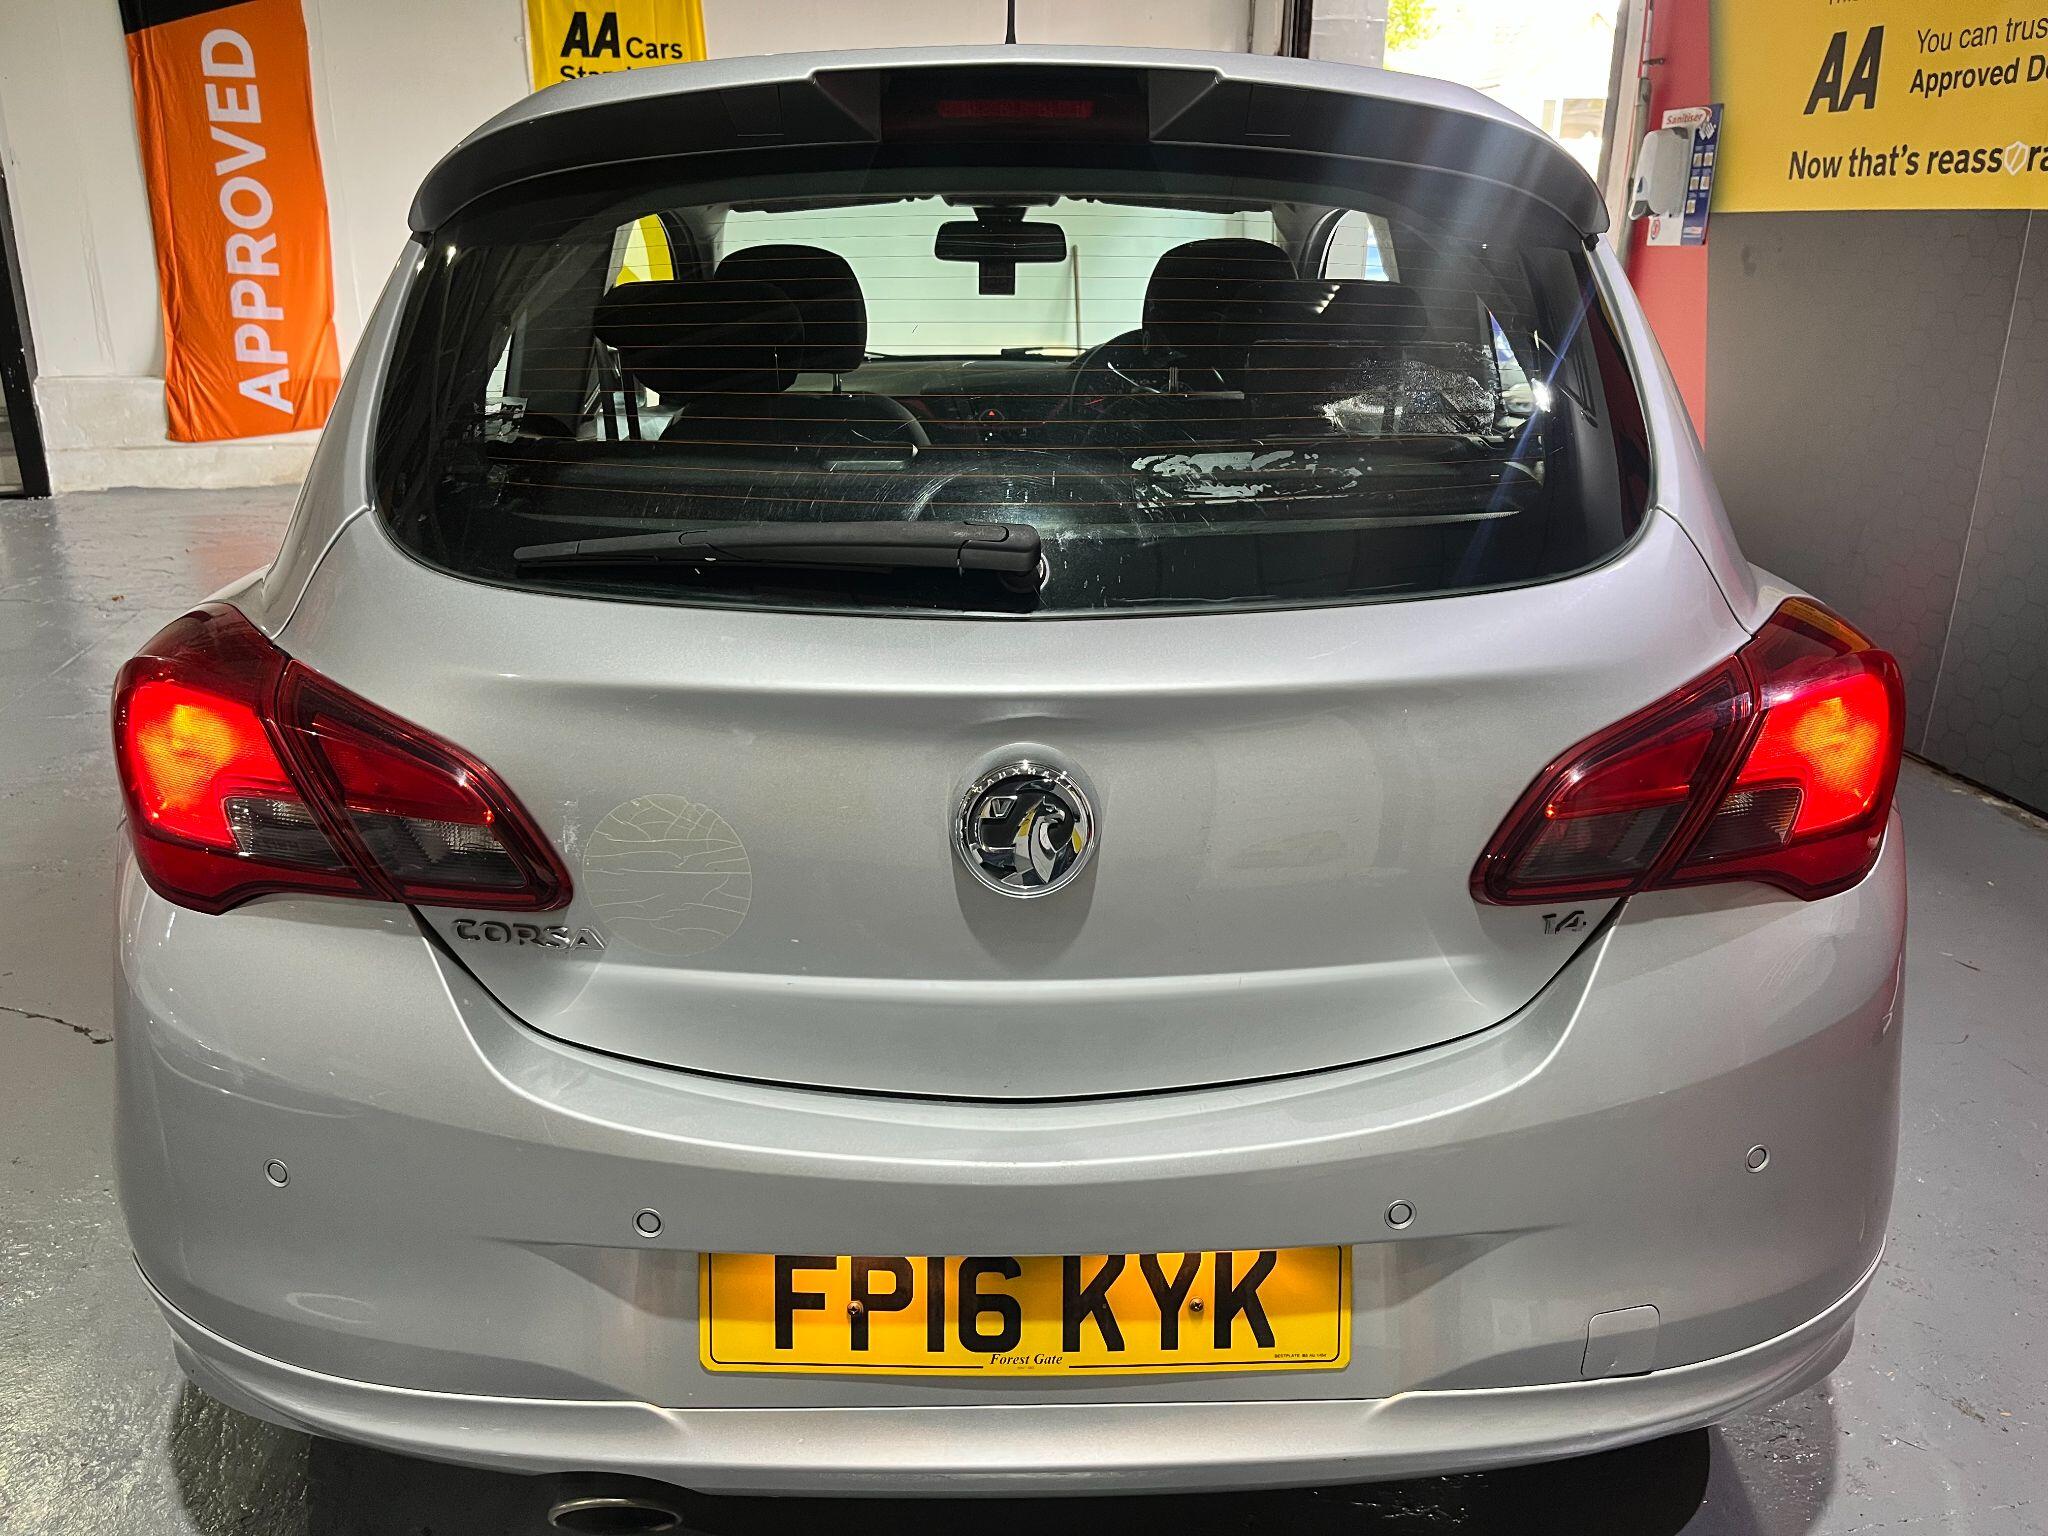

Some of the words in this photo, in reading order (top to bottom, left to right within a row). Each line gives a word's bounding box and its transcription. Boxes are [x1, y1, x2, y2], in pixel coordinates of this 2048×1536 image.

[560, 11, 621, 58] AA
[626, 37, 683, 59] Cars
[1917, 28, 1952, 54] You
[1959, 24, 1998, 49] can
[1803, 25, 1885, 115] AA
[1909, 57, 2020, 98] Approved
[1788, 150, 1843, 179] Now
[1848, 143, 1920, 177] that's
[201, 28, 294, 415] APPROVED
[452, 918, 606, 950] CORSA
[774, 1255, 1022, 1353] FP16
[1062, 1251, 1278, 1352] KYK
[989, 1353, 1030, 1365] Forest
[1033, 1353, 1063, 1365] Gate
